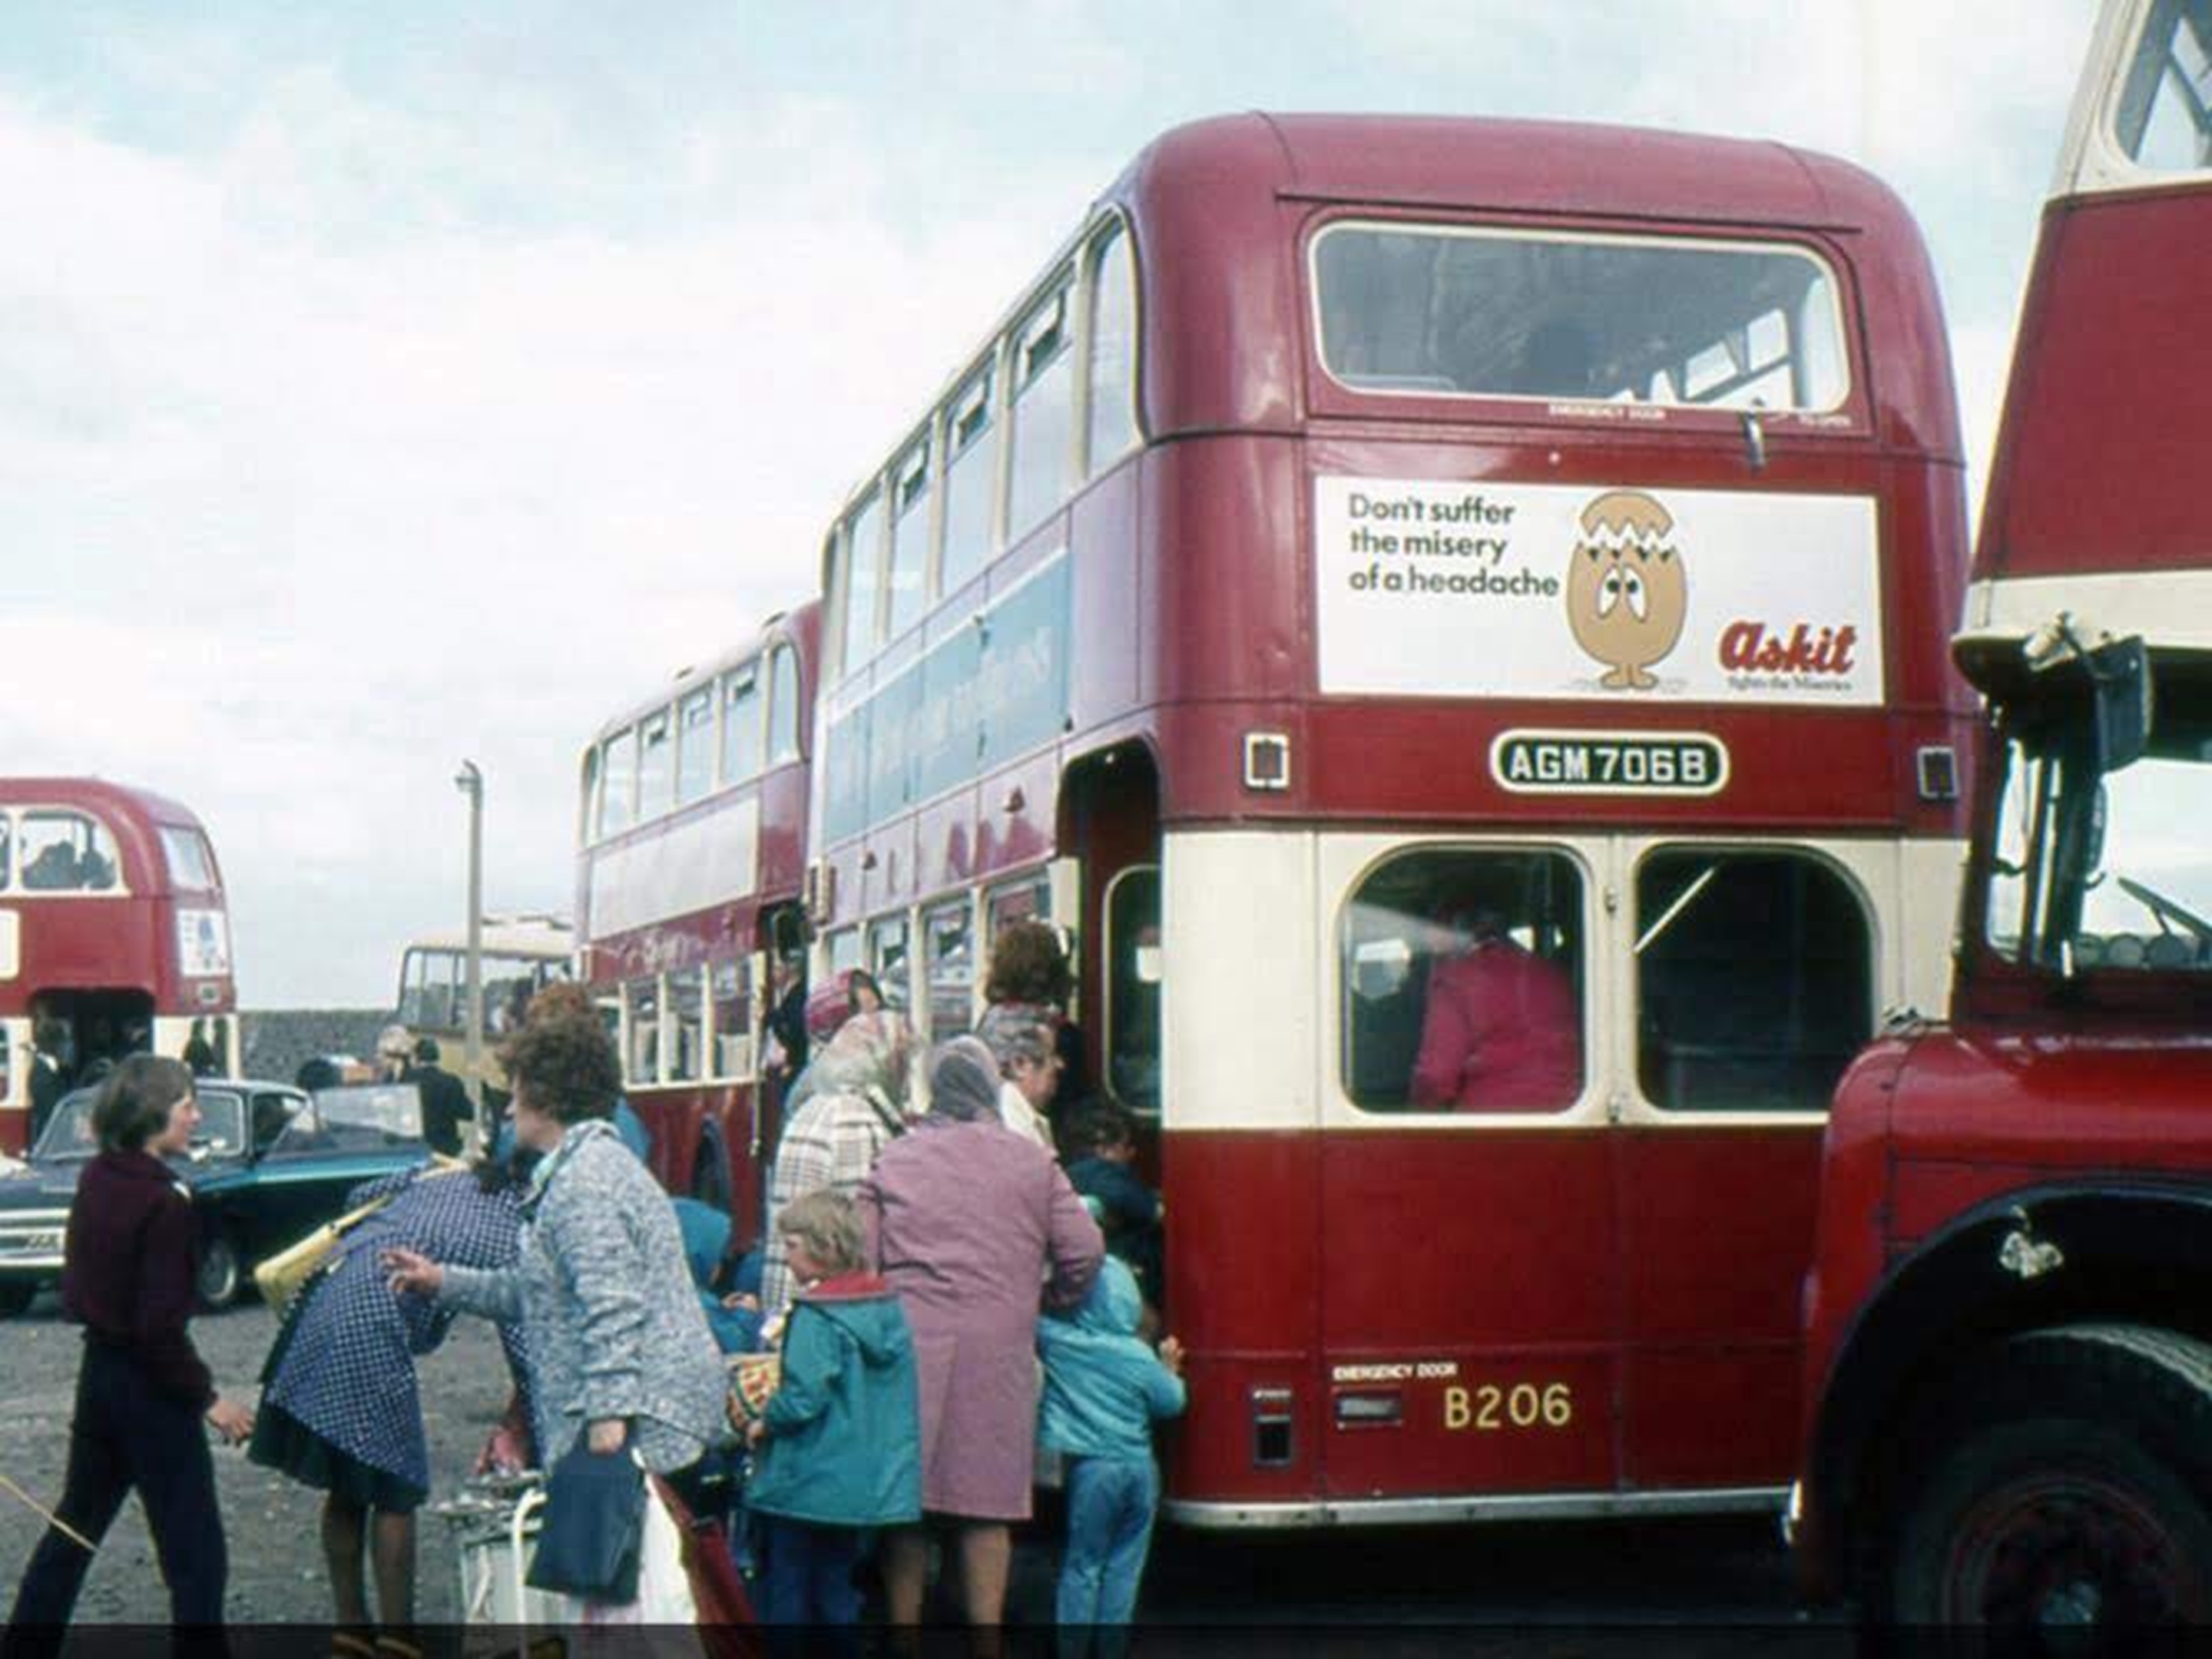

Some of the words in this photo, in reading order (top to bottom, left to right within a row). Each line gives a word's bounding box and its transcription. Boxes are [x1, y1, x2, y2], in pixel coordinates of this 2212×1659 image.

[1349, 493, 1424, 521] Don't
[1429, 496, 1516, 524] suffer
[1350, 527, 1399, 554] the
[1404, 529, 1508, 565] misery
[1349, 562, 1380, 591] of
[1383, 572, 1402, 591] a
[1408, 564, 1560, 597] headache
[1332, 1364, 1414, 1382] EMERGENCY
[1417, 1361, 1458, 1379] DOOR
[1445, 1383, 1571, 1429] B206
